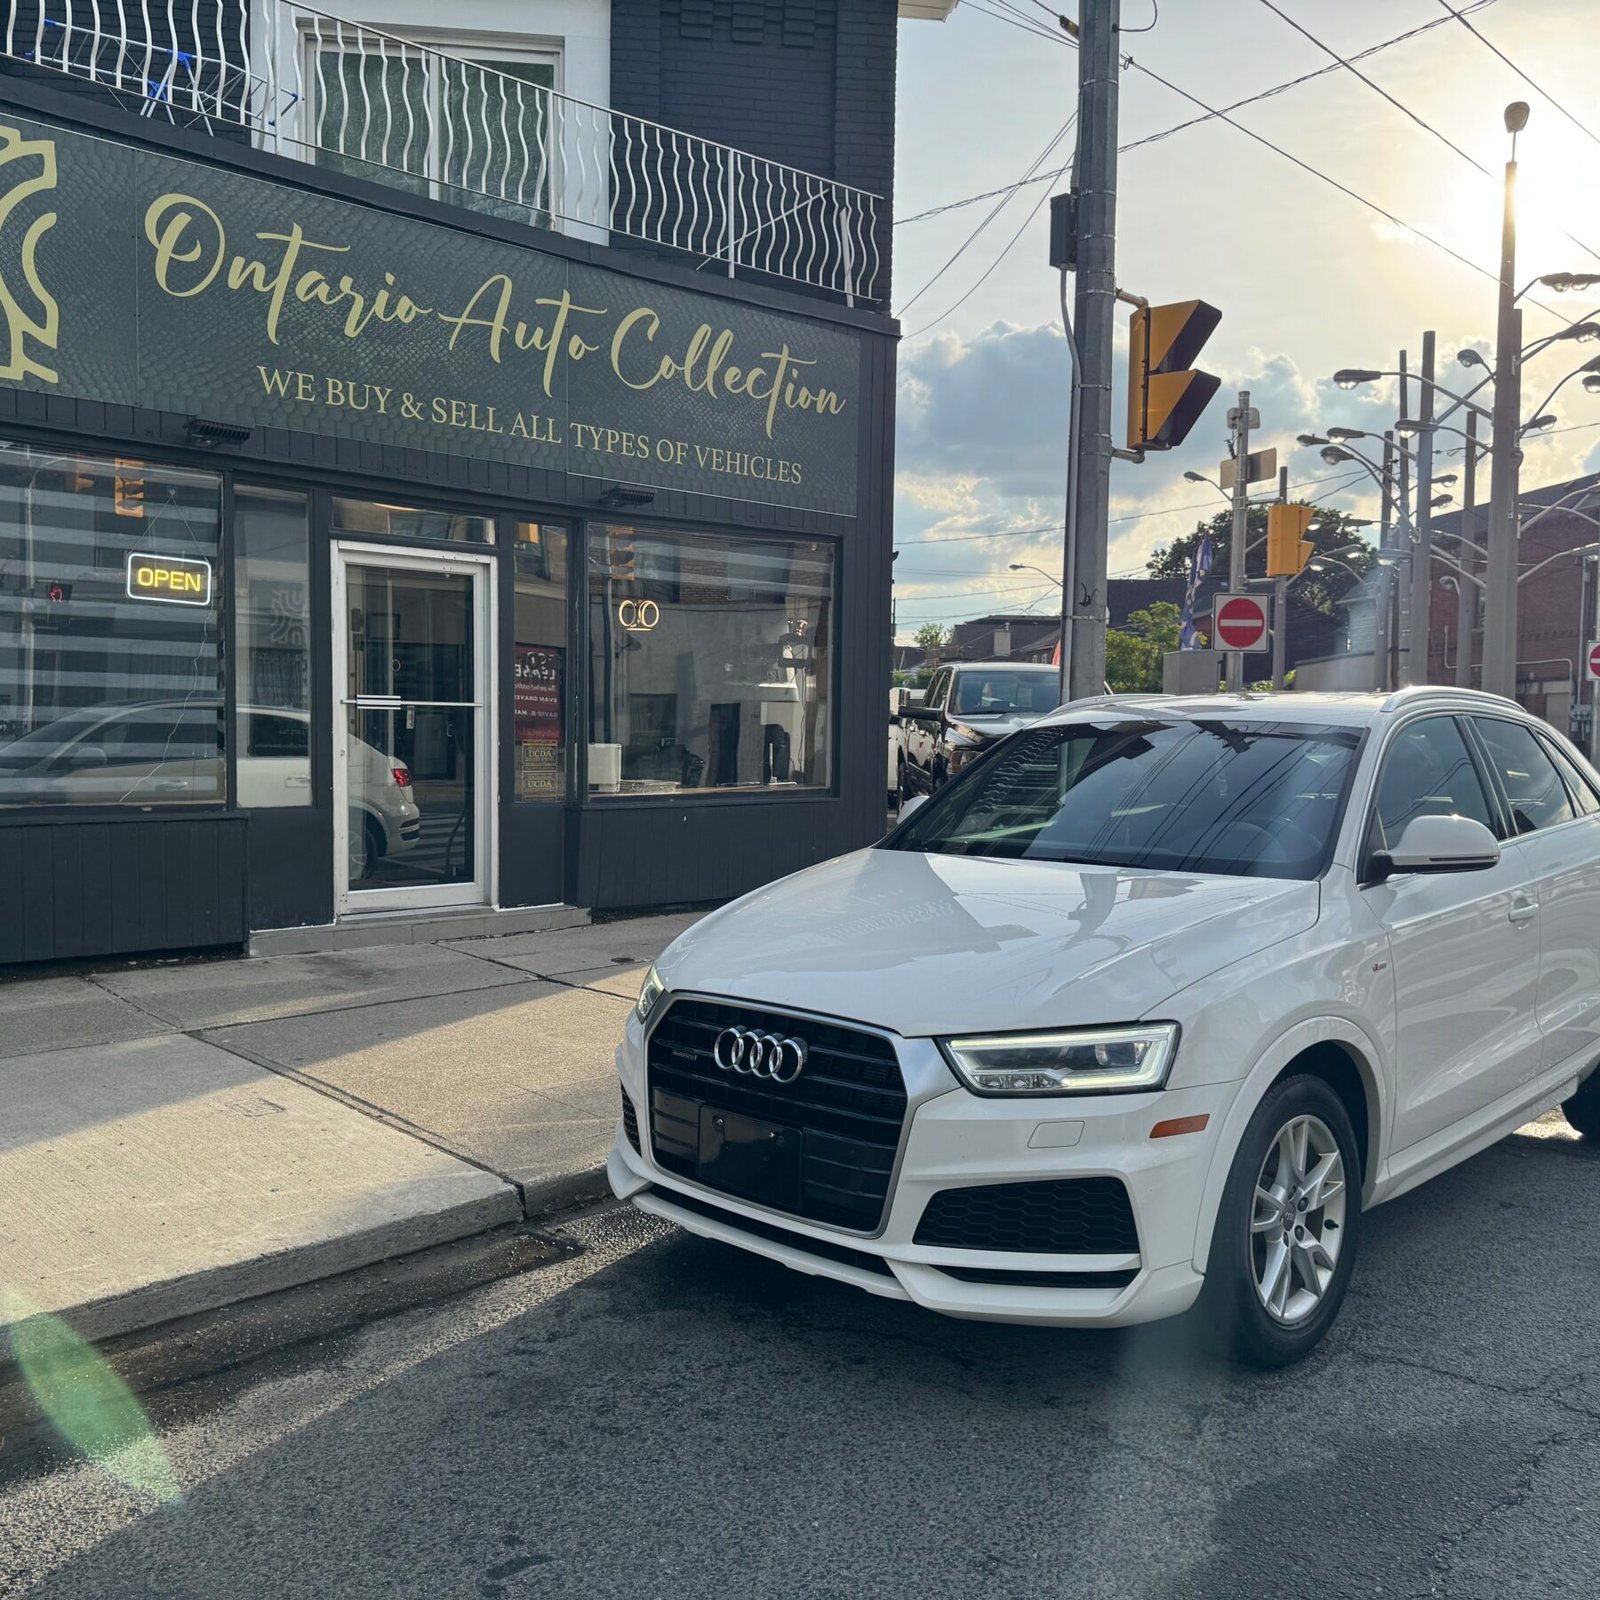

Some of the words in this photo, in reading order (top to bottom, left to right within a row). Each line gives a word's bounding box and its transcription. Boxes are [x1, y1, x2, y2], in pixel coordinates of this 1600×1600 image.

[144, 192, 433, 346] Ontario
[437, 274, 608, 398] Auto
[610, 307, 846, 440] Collection
[256, 365, 316, 402] WE
[325, 377, 393, 414] BUY
[400, 392, 424, 420] &
[431, 397, 503, 433] SELL
[509, 412, 562, 443] ALL
[570, 422, 650, 459] TYPES
[656, 439, 689, 465] OF
[694, 444, 802, 485] VEHICLES
[138, 567, 201, 592] OPEN
[528, 749, 553, 758] UCDA
[527, 780, 552, 788] UCDA
